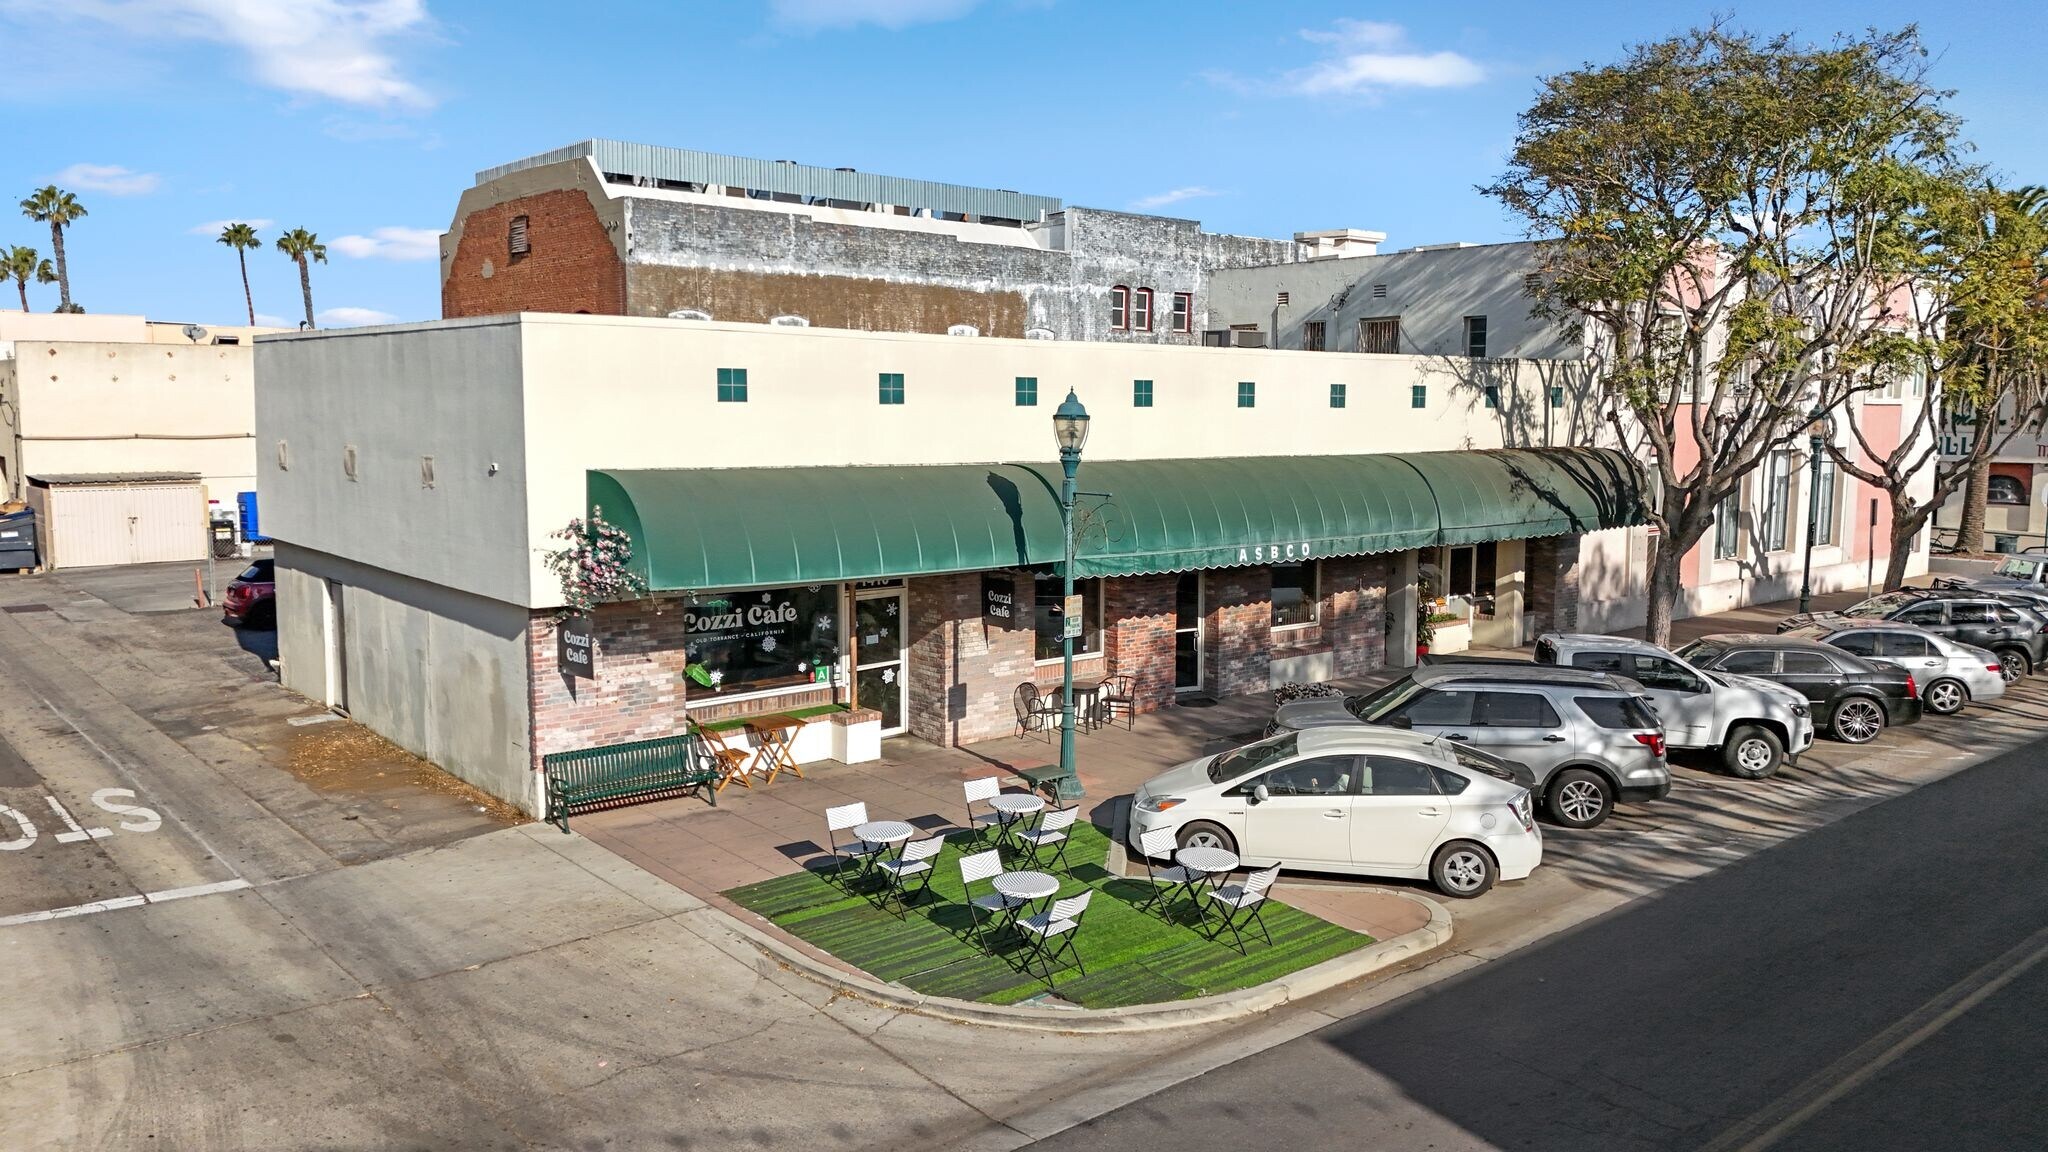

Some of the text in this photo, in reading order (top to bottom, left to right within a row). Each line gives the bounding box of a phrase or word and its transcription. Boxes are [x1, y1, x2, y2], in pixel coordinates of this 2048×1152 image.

[988, 590, 1012, 604] Cozzi
[684, 601, 798, 633] Cozzi Cafe
[989, 605, 1010, 618] Cafe
[564, 630, 589, 648] Cozzi
[745, 629, 785, 638] CALIFORNIA
[566, 648, 588, 664] Cafe
[817, 670, 826, 681] A
